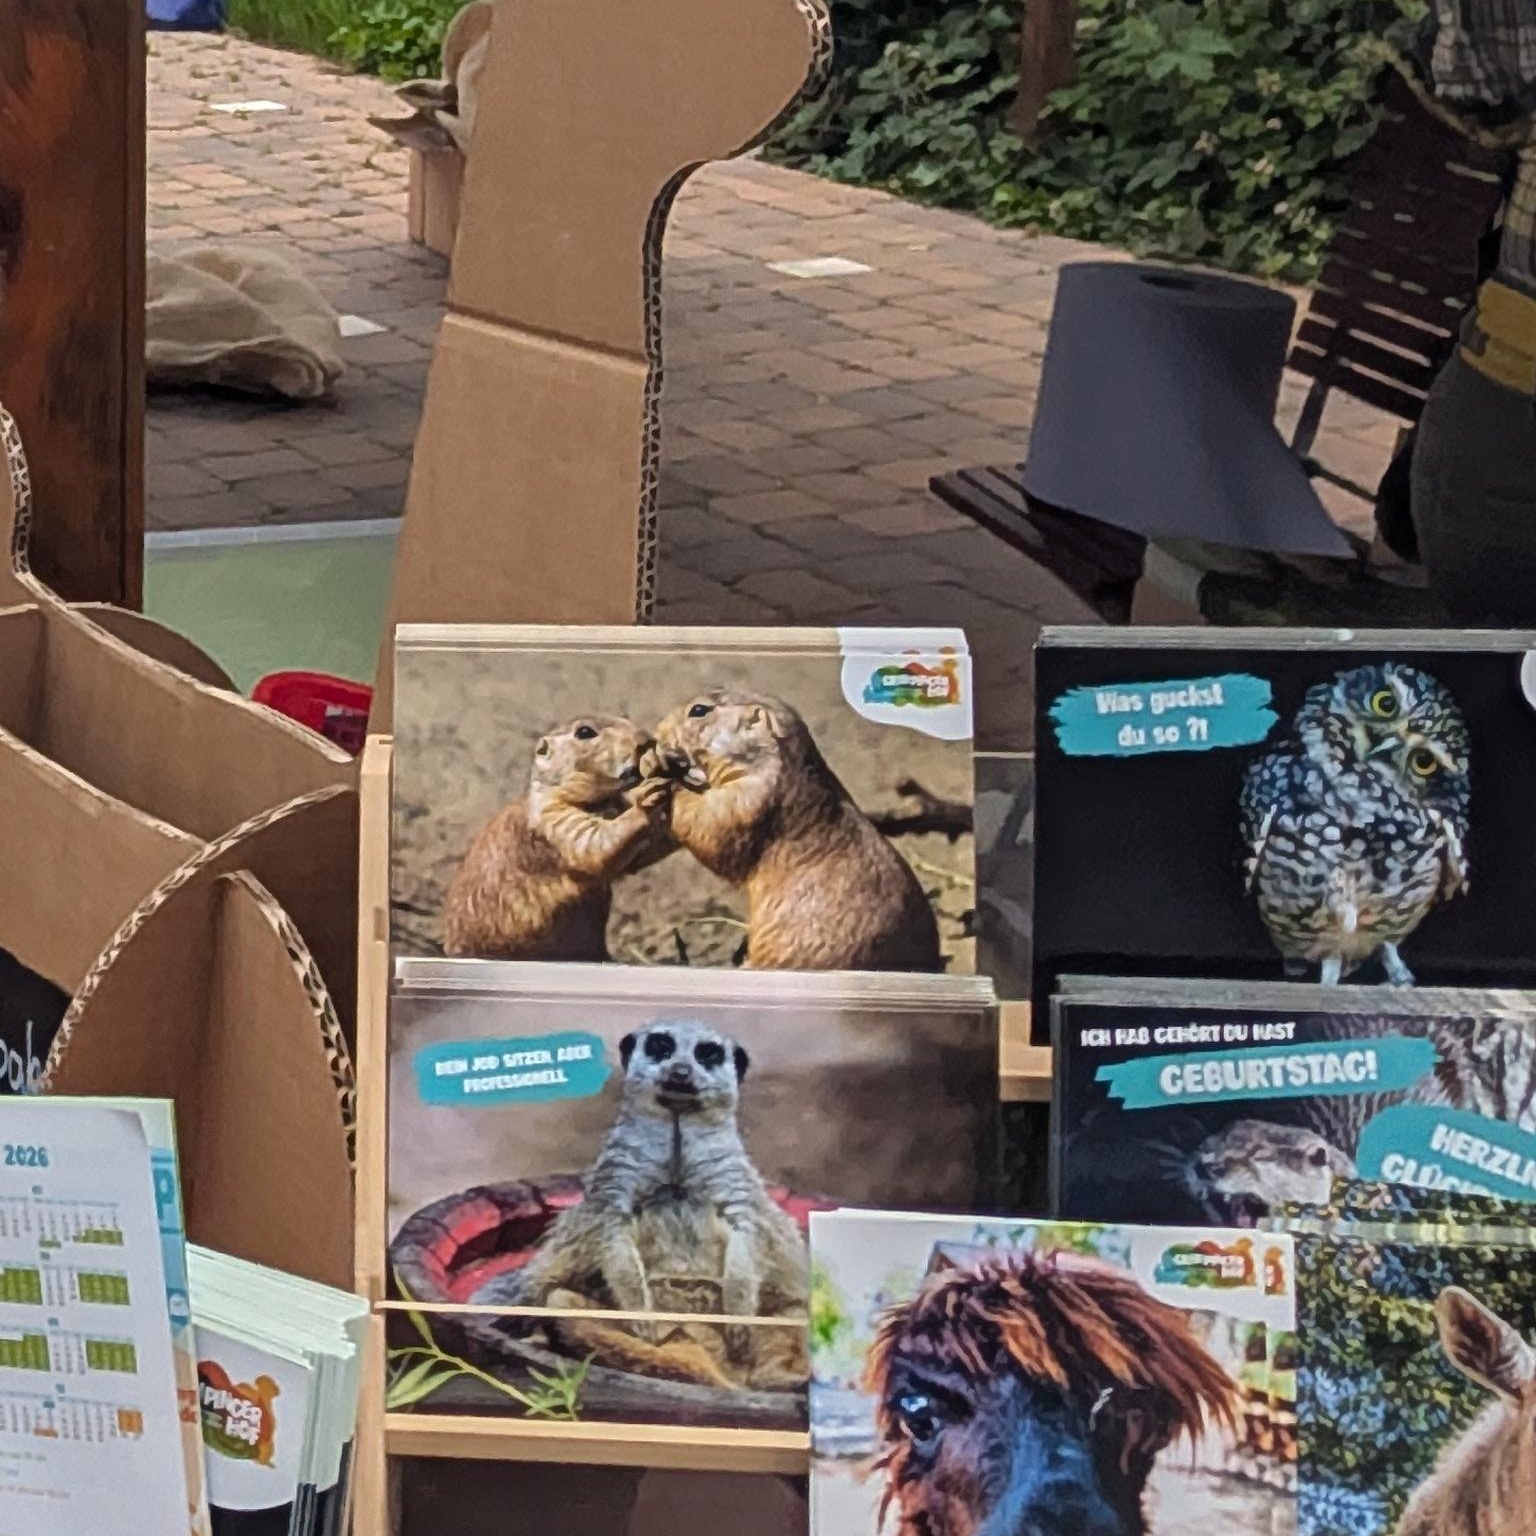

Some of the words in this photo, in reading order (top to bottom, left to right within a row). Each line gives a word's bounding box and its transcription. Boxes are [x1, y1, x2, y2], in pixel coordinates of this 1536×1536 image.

[1095, 691, 1143, 714] Was
[1150, 682, 1224, 715] guckst
[1118, 724, 1146, 747] du
[1153, 725, 1179, 745] so
[1080, 1029, 1111, 1047] ICH
[1115, 1027, 1150, 1046] HAB
[1223, 1022, 1249, 1041] DU
[1253, 1022, 1296, 1041] HAST
[1159, 1049, 1378, 1096] GEBURTSTAG!
